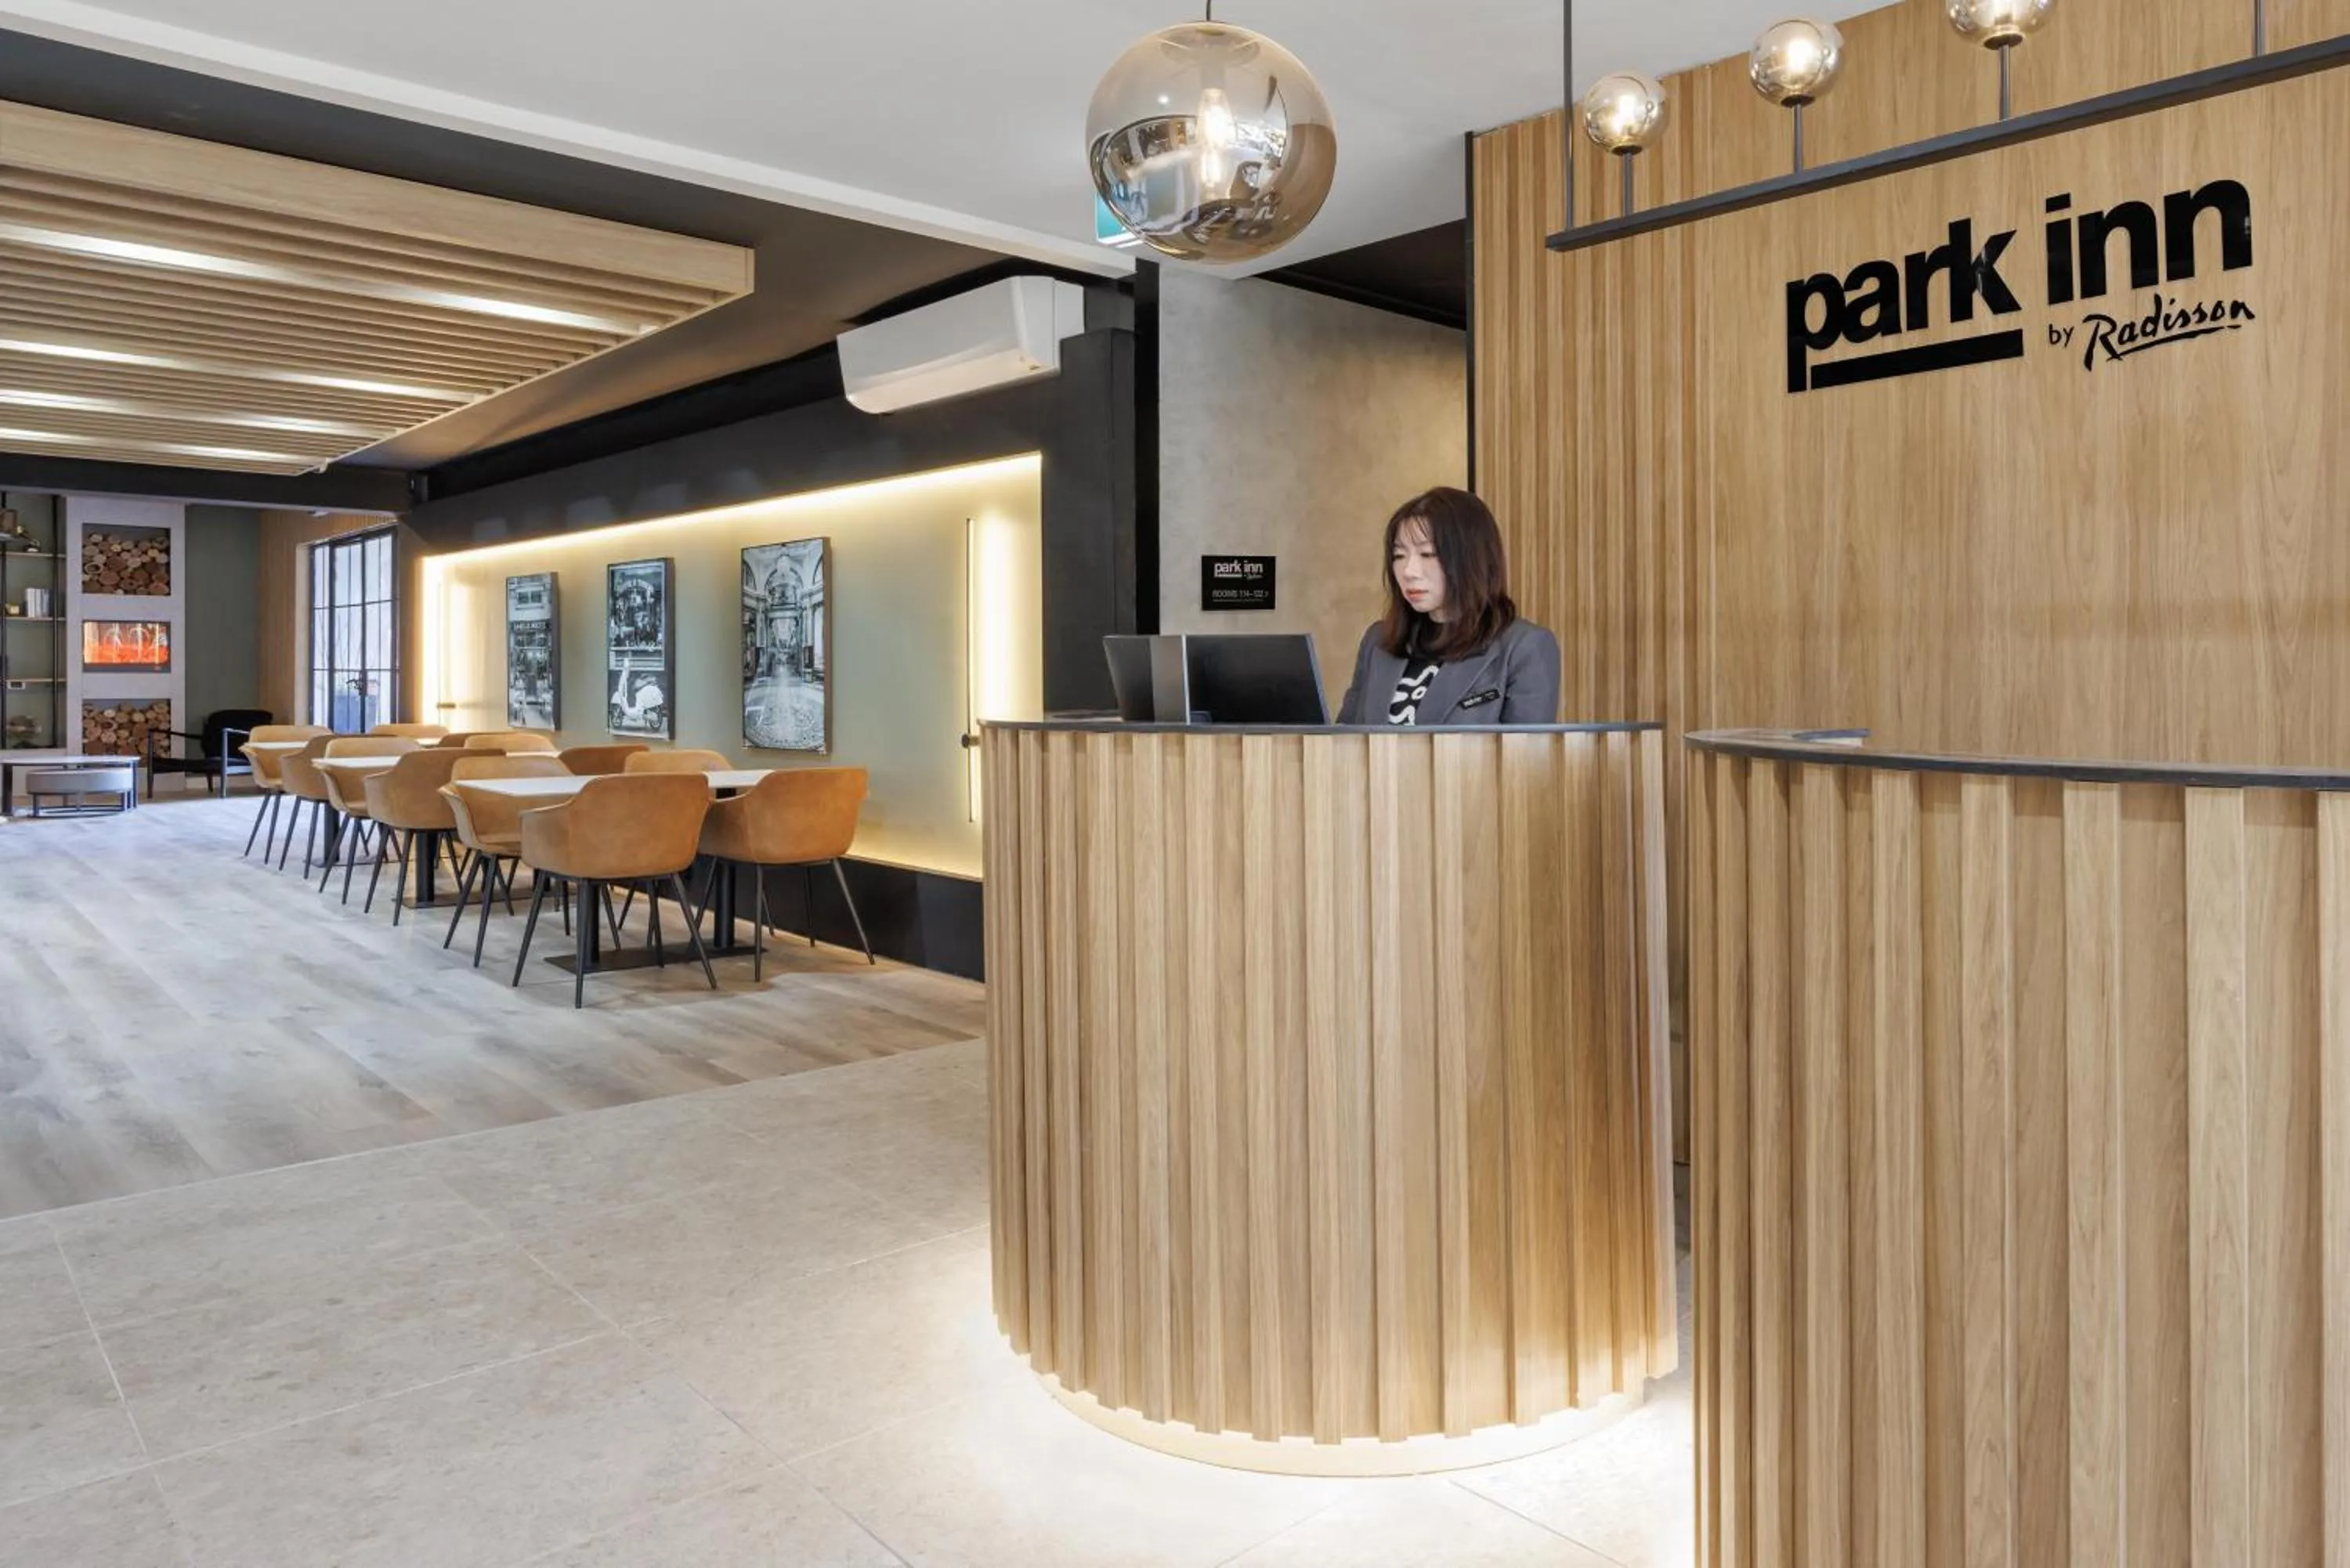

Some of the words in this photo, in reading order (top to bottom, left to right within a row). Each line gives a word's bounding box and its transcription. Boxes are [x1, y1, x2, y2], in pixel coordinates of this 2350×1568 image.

[1785, 218, 2023, 394] park
[2045, 179, 2253, 305] inn
[2048, 323, 2074, 347] by
[2083, 293, 2255, 372] Radisson
[1214, 559, 1242, 577] park
[1243, 560, 1263, 573] inn
